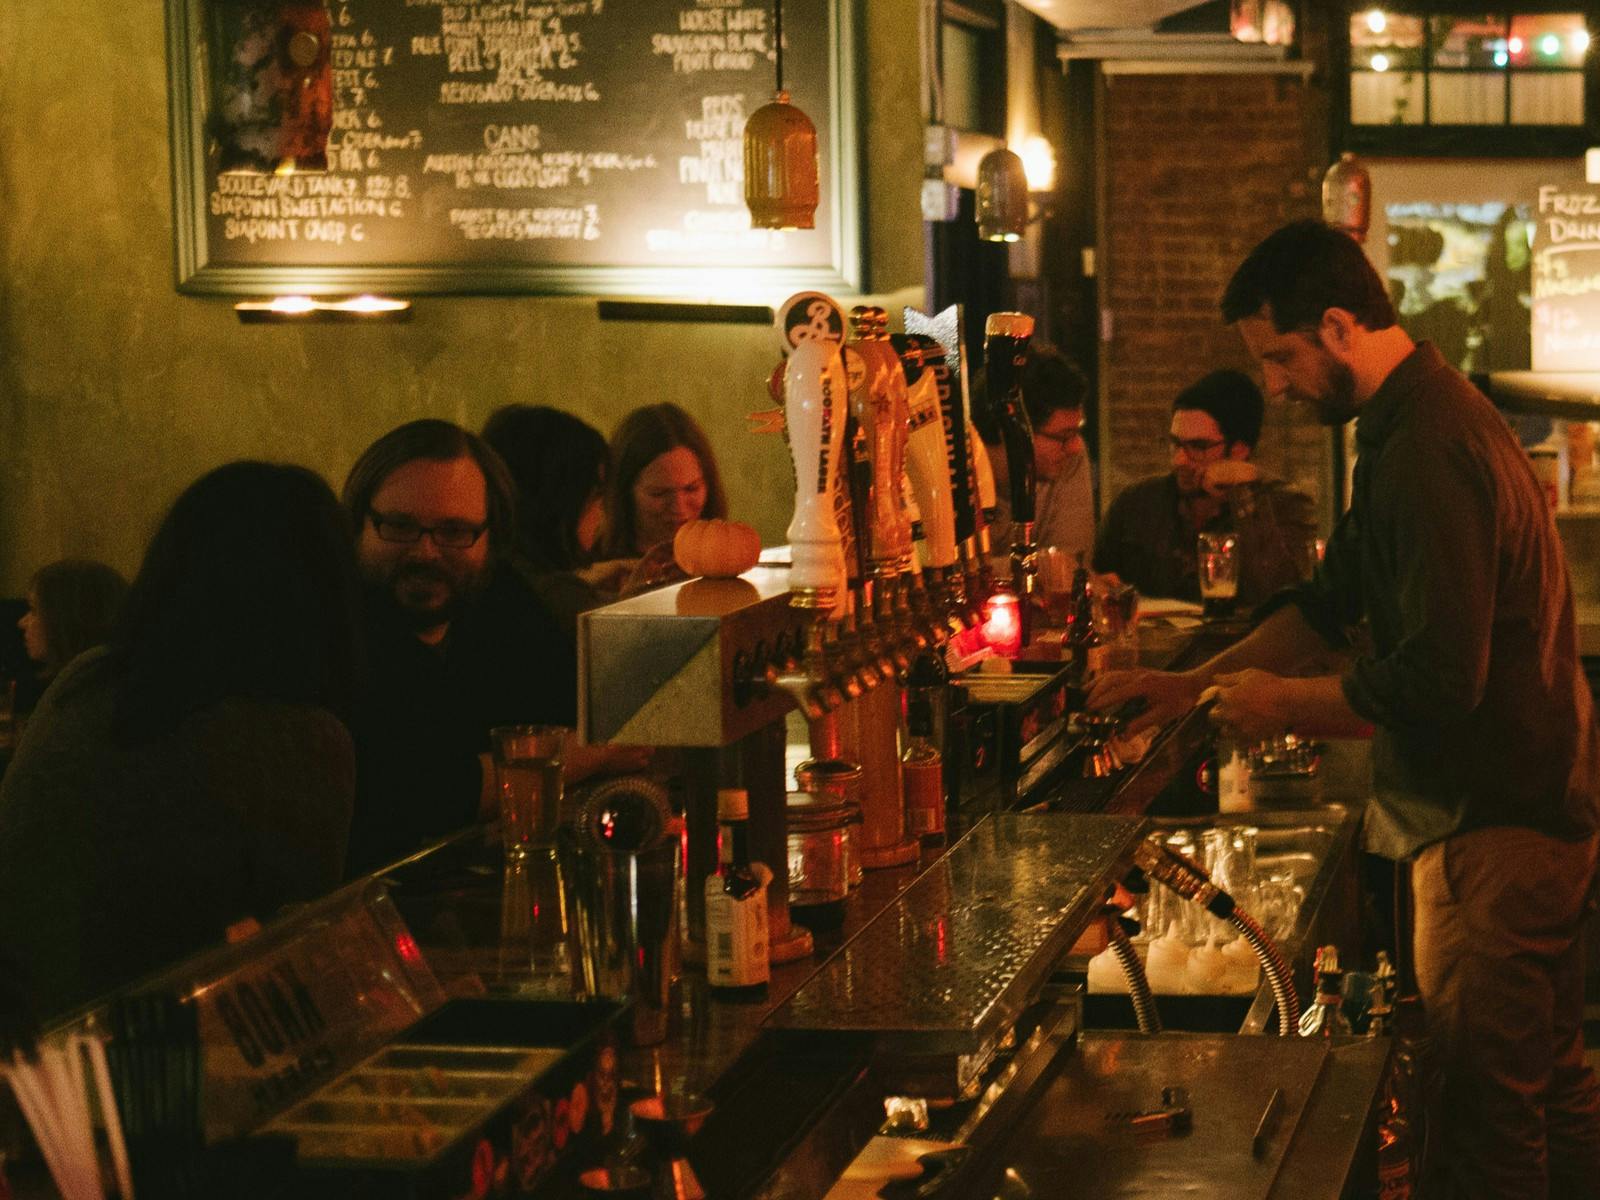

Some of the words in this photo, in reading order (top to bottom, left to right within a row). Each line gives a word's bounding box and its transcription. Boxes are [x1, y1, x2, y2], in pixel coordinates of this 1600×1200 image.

[482, 124, 541, 150] CANS
[820, 367, 832, 445] ROOKLYN
[817, 449, 830, 494] LAGER
